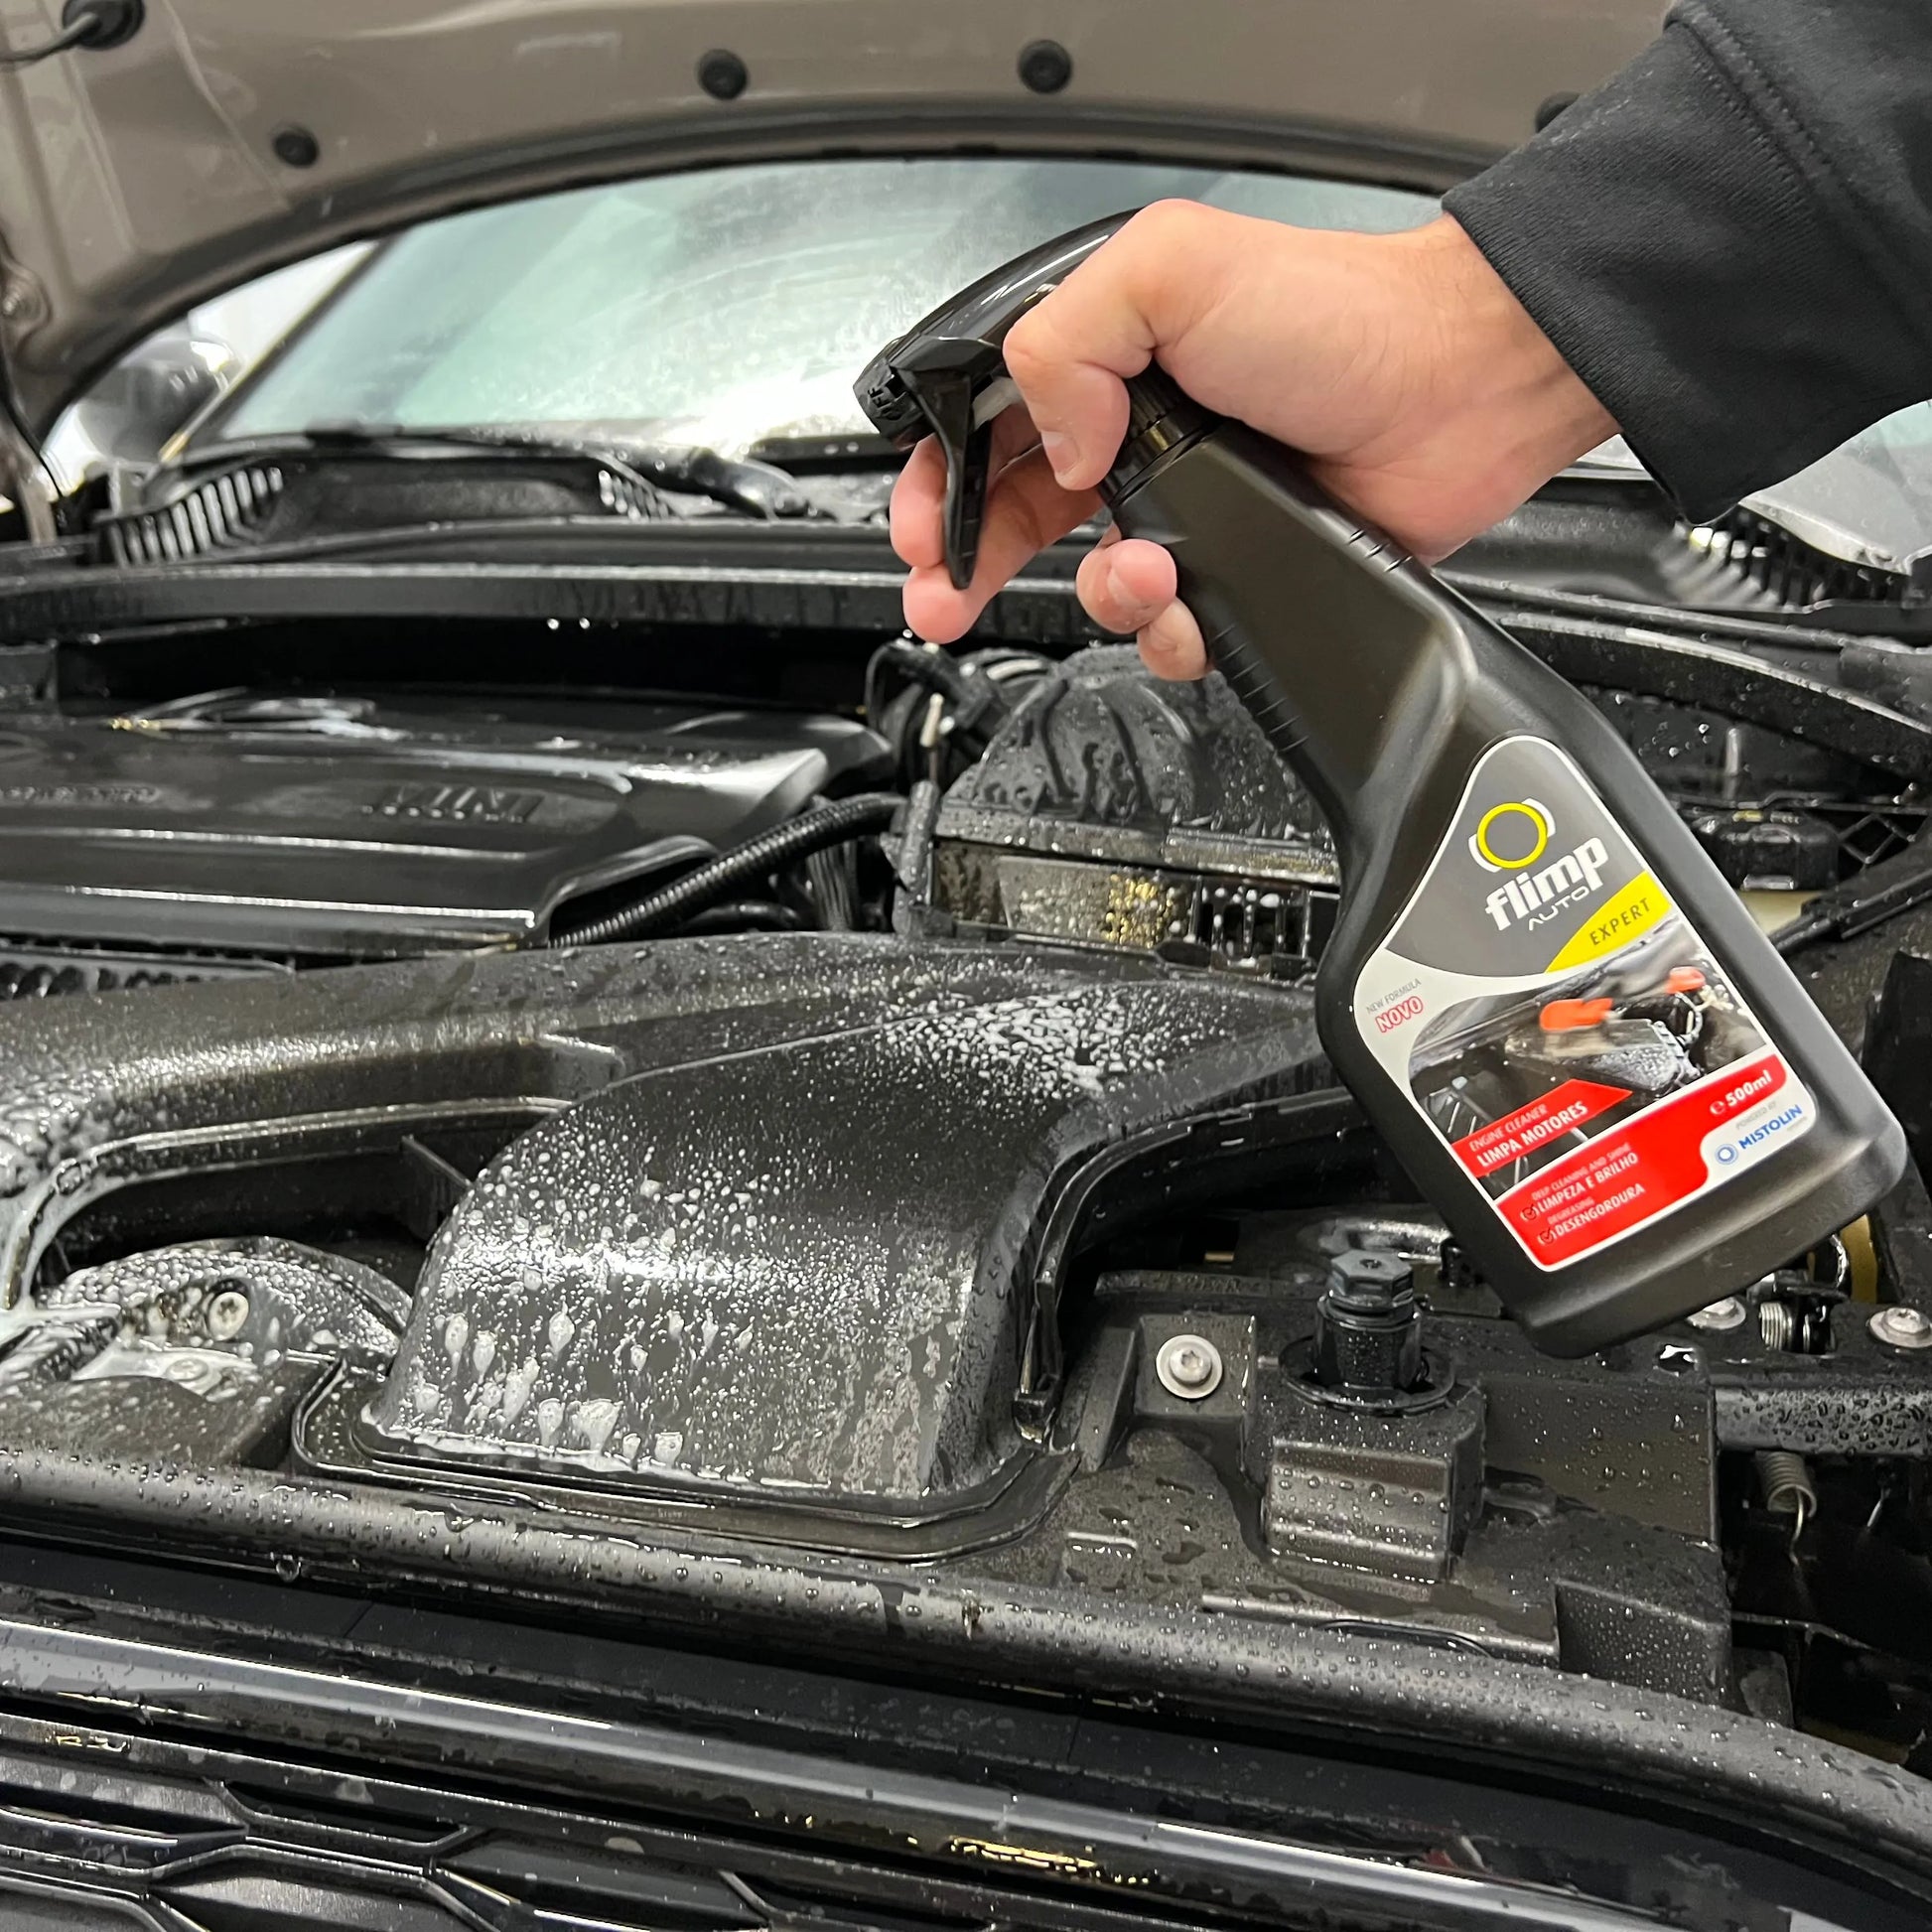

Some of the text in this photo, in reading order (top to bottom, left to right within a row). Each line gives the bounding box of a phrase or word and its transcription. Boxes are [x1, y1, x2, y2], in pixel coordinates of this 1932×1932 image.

[1485, 837, 1608, 931] flimp
[1528, 886, 1589, 931] AUTO
[1589, 897, 1651, 946] EXPERT
[1366, 978, 1422, 1014] NEW FORMULA
[1375, 996, 1424, 1033] NOVO
[1725, 1069, 1772, 1107] 500ml
[1469, 1104, 1548, 1152] ENGINE CLEANER
[1476, 1101, 1587, 1168] LIMPA MOTORES
[1738, 1104, 1803, 1150] MISTOLIN
[1532, 1186, 1551, 1201] DEEP
[1551, 1167, 1588, 1191] CLEANING
[1589, 1157, 1606, 1172] AND
[1538, 1152, 1638, 1212] LIMPEZA E BRILHO
[1547, 1196, 1594, 1225] DEGREASING
[1555, 1182, 1646, 1236] DESENGORDURA
